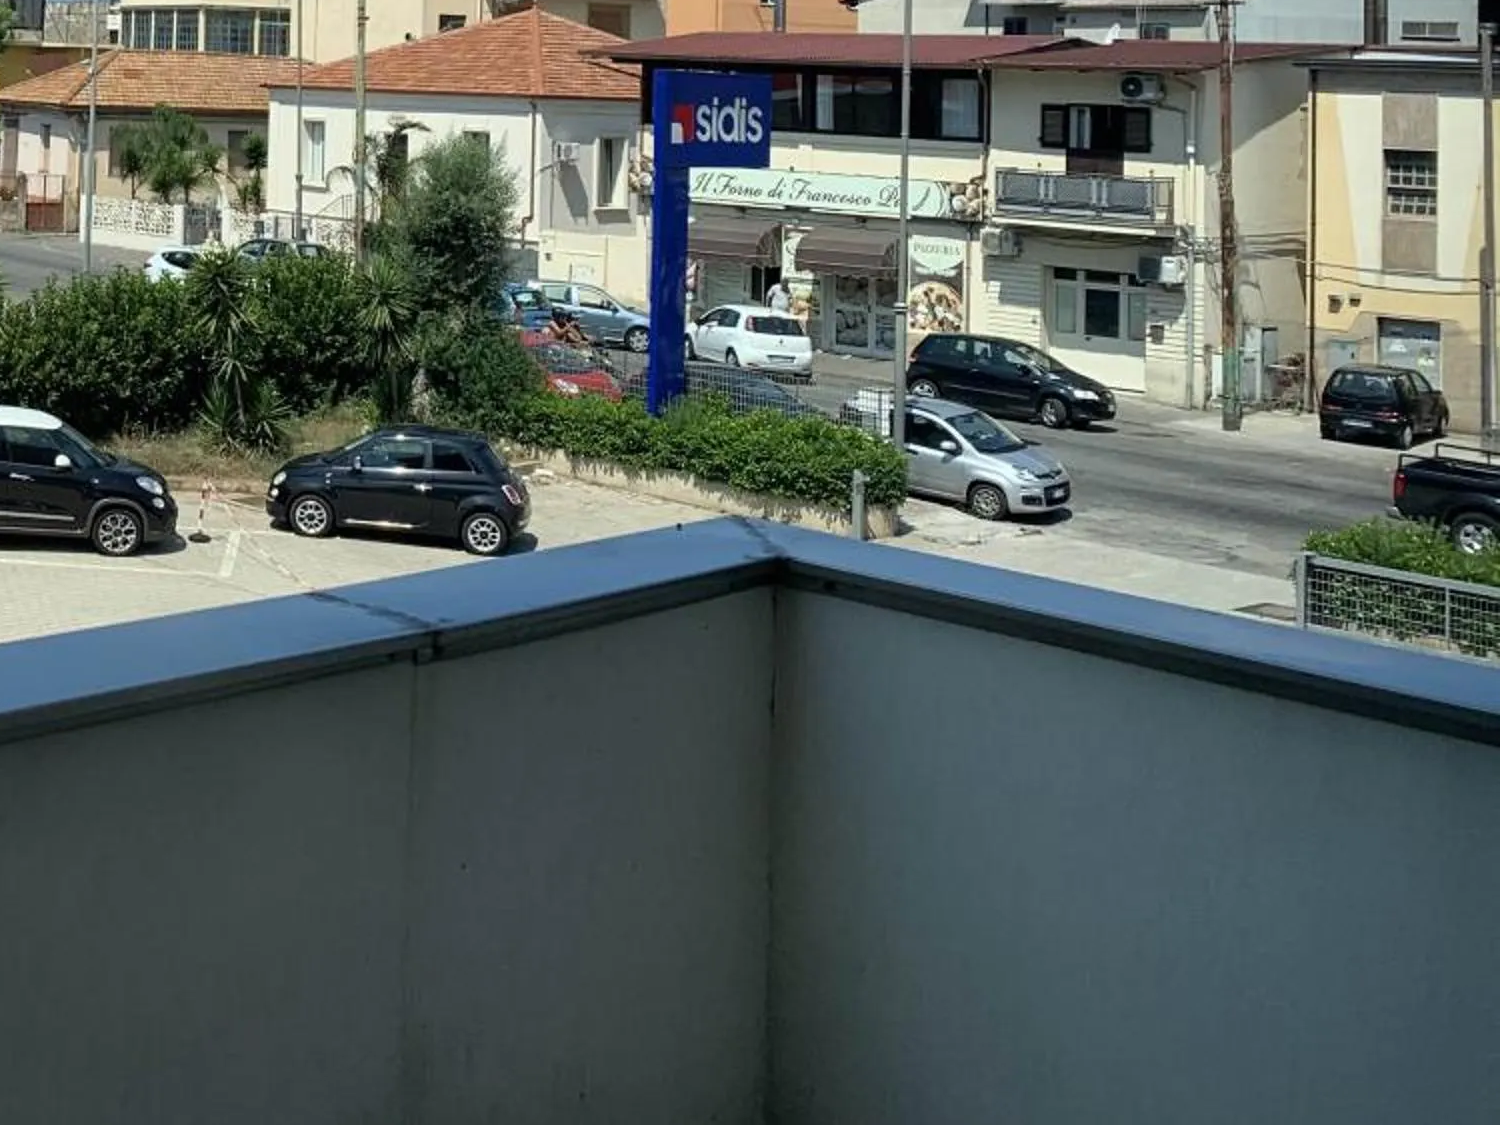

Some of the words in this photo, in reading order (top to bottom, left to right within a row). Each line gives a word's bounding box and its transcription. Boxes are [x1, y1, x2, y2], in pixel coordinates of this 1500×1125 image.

[696, 96, 763, 143] sidis
[713, 173, 763, 196] Forno
[767, 176, 785, 199] di
[789, 178, 871, 205] Francesco
[876, 183, 906, 208] Pi
